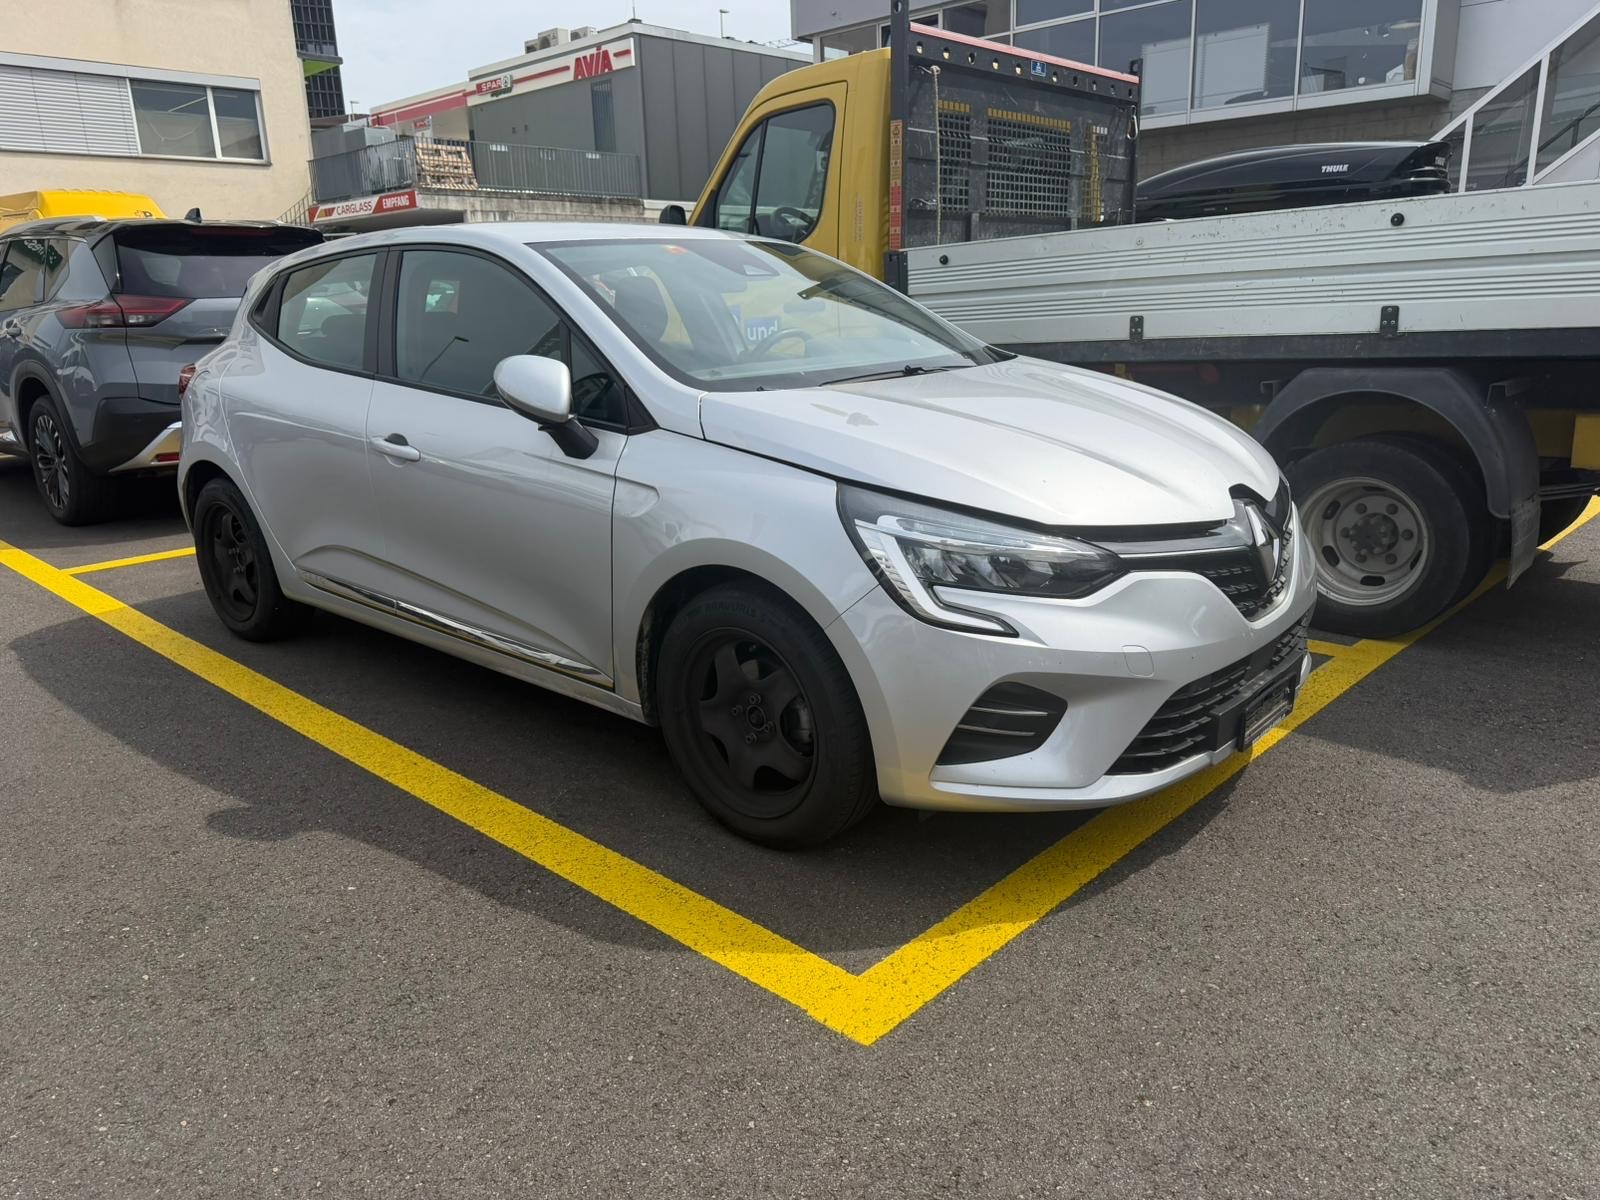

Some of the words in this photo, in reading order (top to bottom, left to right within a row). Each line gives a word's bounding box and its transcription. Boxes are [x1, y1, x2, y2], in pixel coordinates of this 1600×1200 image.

[573, 45, 613, 80] AVIA
[480, 79, 502, 93] SPAR
[1321, 163, 1350, 174] THULE
[336, 201, 373, 216] CARGLASS
[382, 194, 410, 209] EMPFANG
